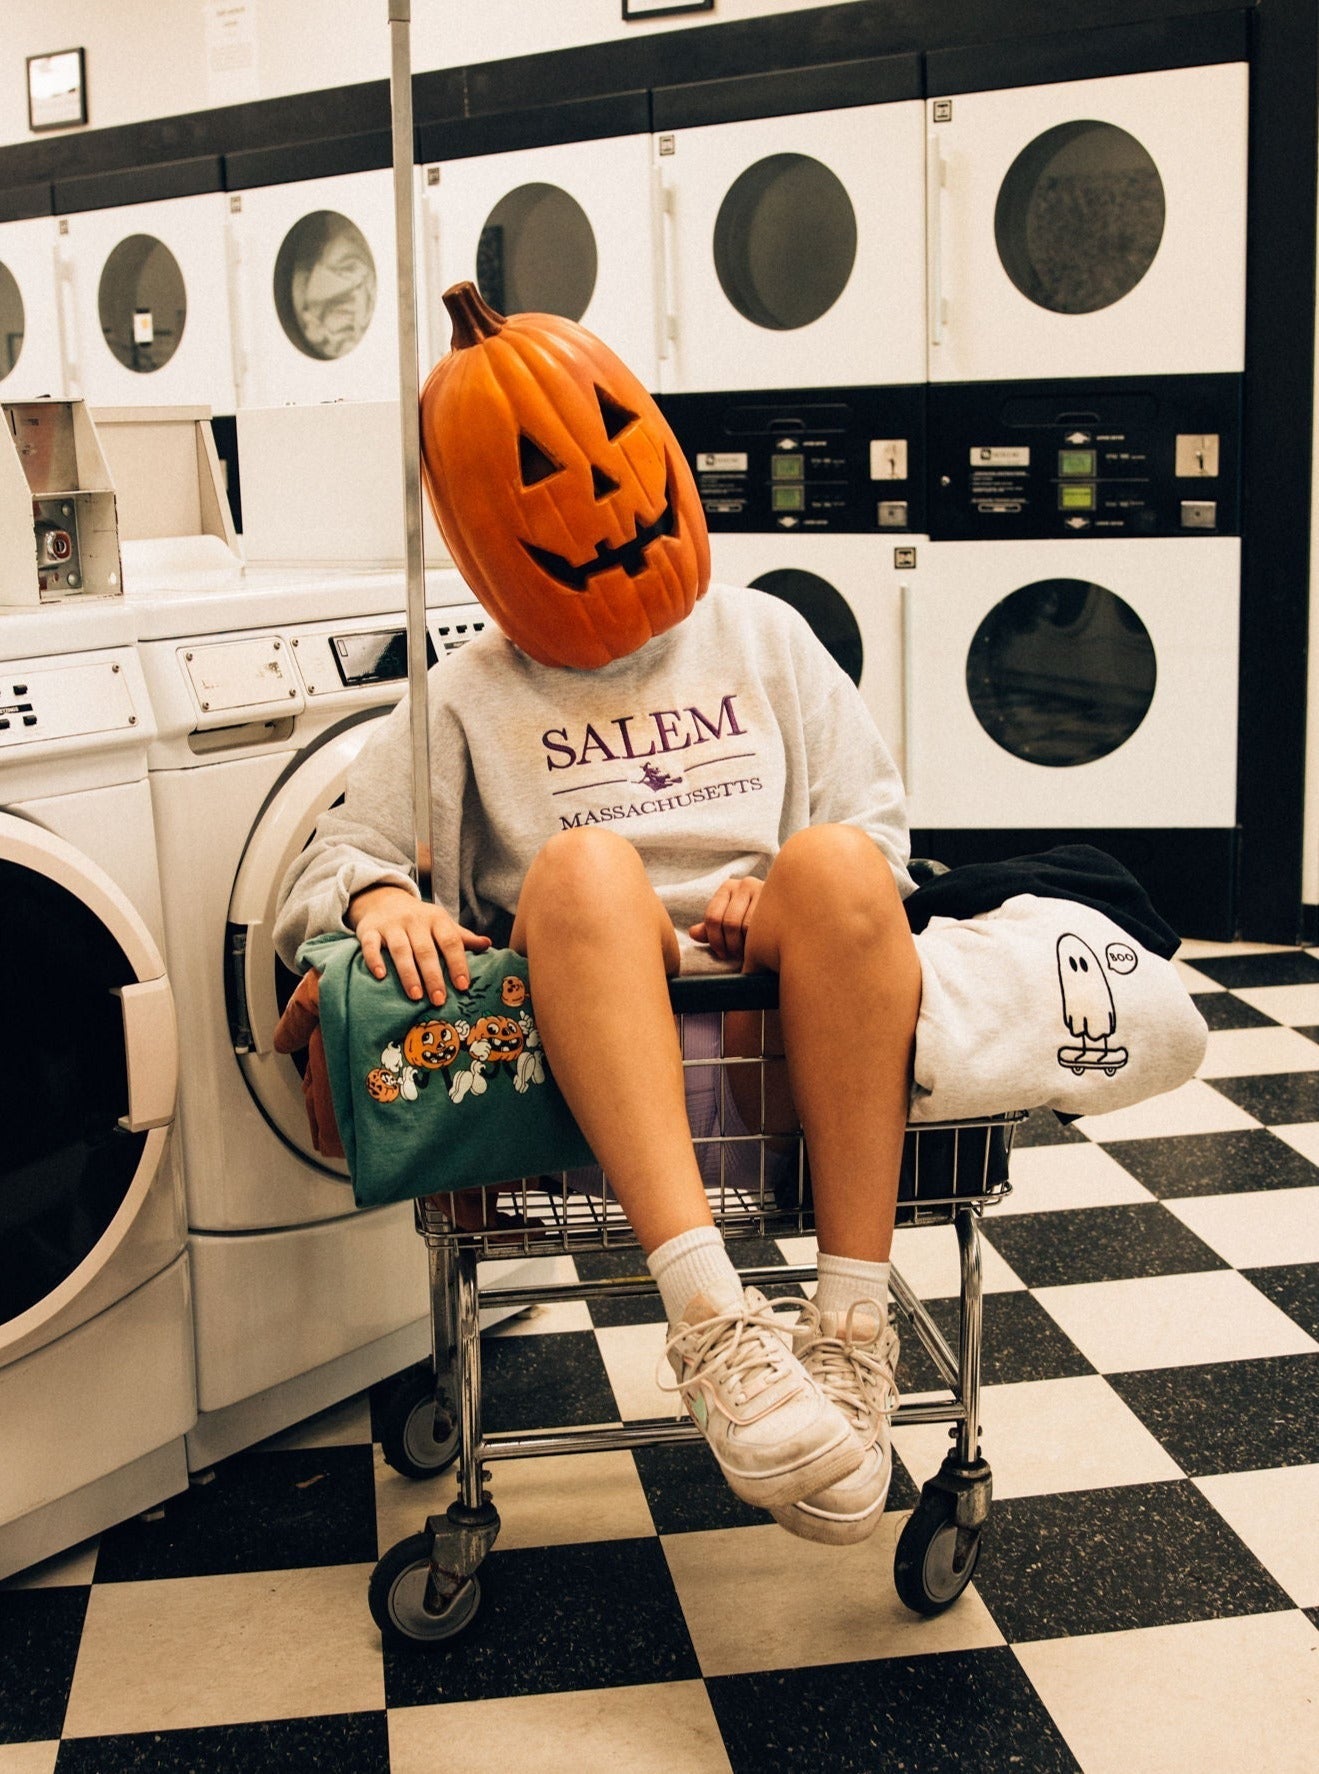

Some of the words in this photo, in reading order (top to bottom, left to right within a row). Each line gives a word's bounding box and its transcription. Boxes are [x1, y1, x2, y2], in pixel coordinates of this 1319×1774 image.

[541, 694, 748, 772] SALEM
[558, 777, 764, 831] MASSACHUSETTS
[1109, 952, 1134, 962] BOO
